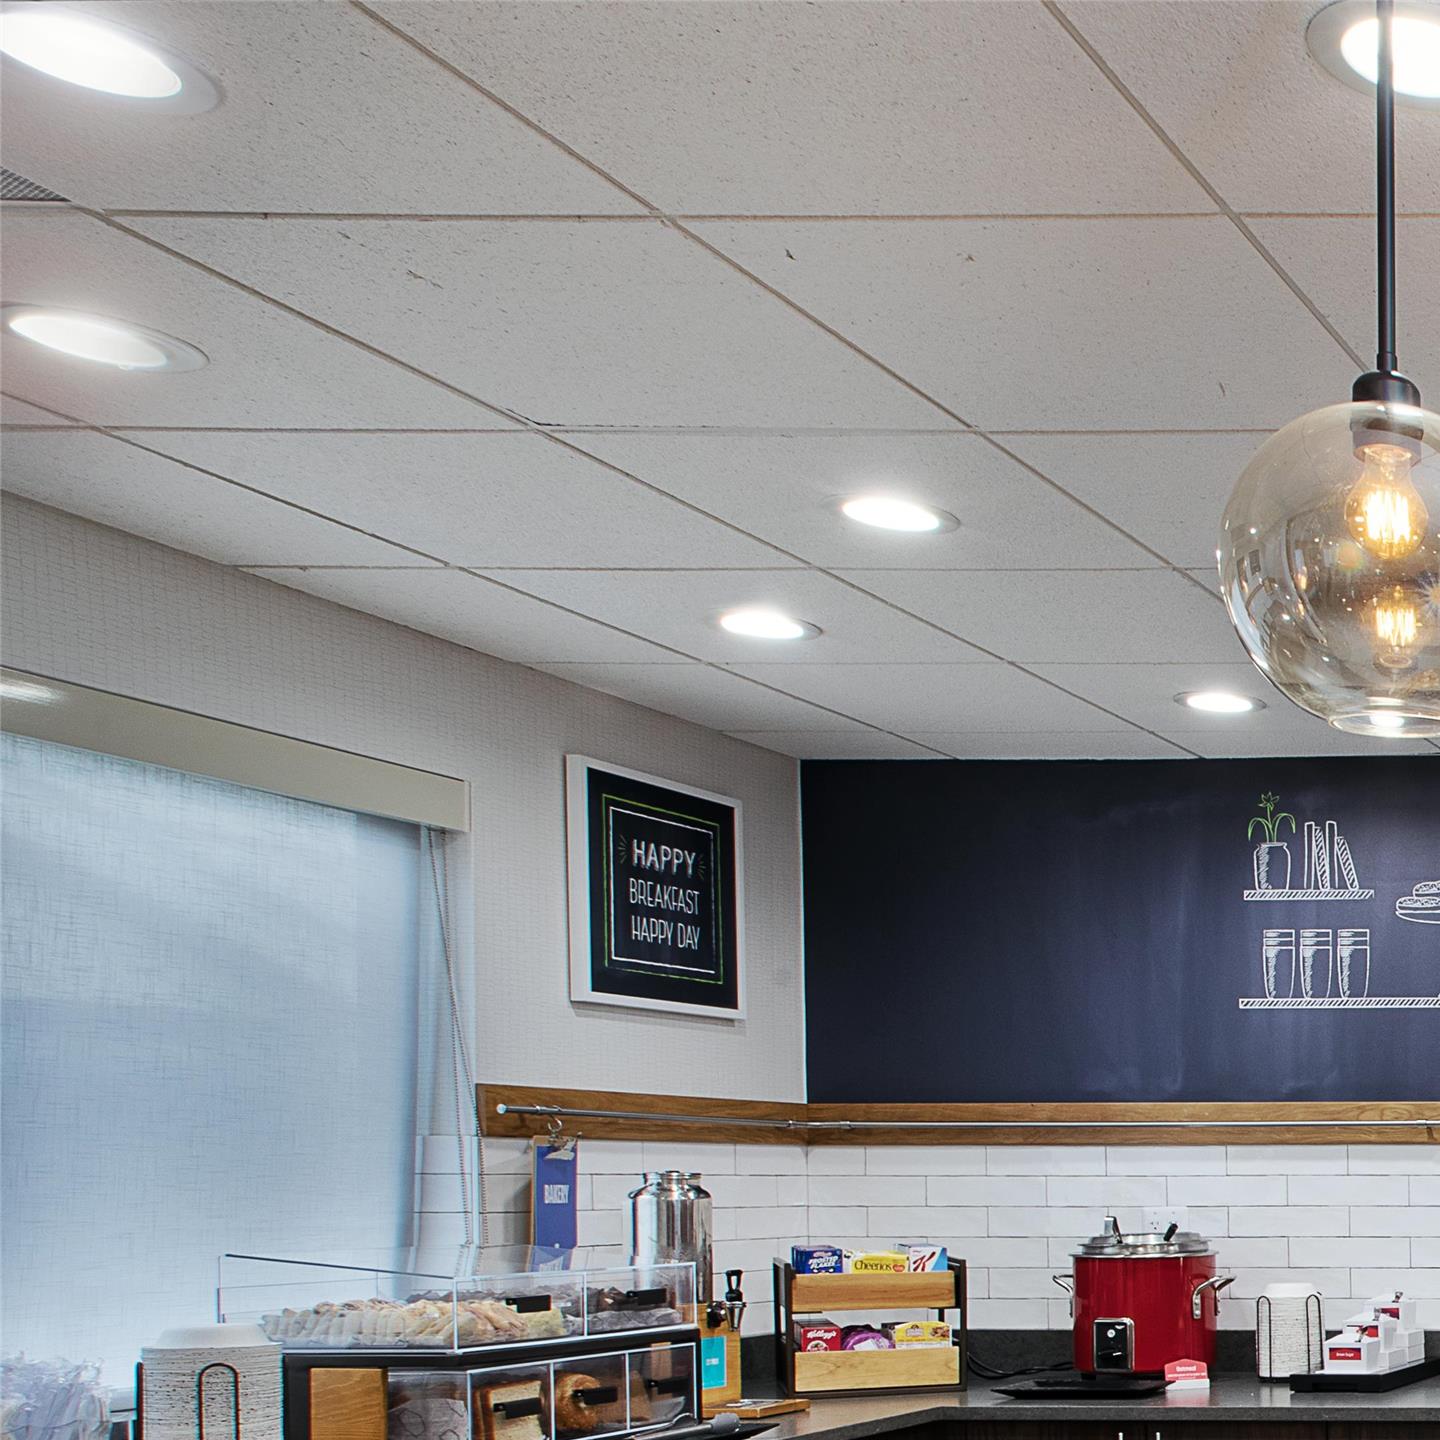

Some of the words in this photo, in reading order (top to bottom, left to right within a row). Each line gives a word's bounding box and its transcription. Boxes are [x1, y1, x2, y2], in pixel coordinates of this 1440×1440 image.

[632, 838, 696, 878] HAPPY
[629, 878, 700, 915] BREAKFAST
[632, 916, 673, 946] HAPPY
[677, 921, 700, 950] DAY
[544, 1184, 569, 1203] BAKERY
[854, 1260, 892, 1271] Cheerios
[806, 1330, 836, 1339] Kellogg's
